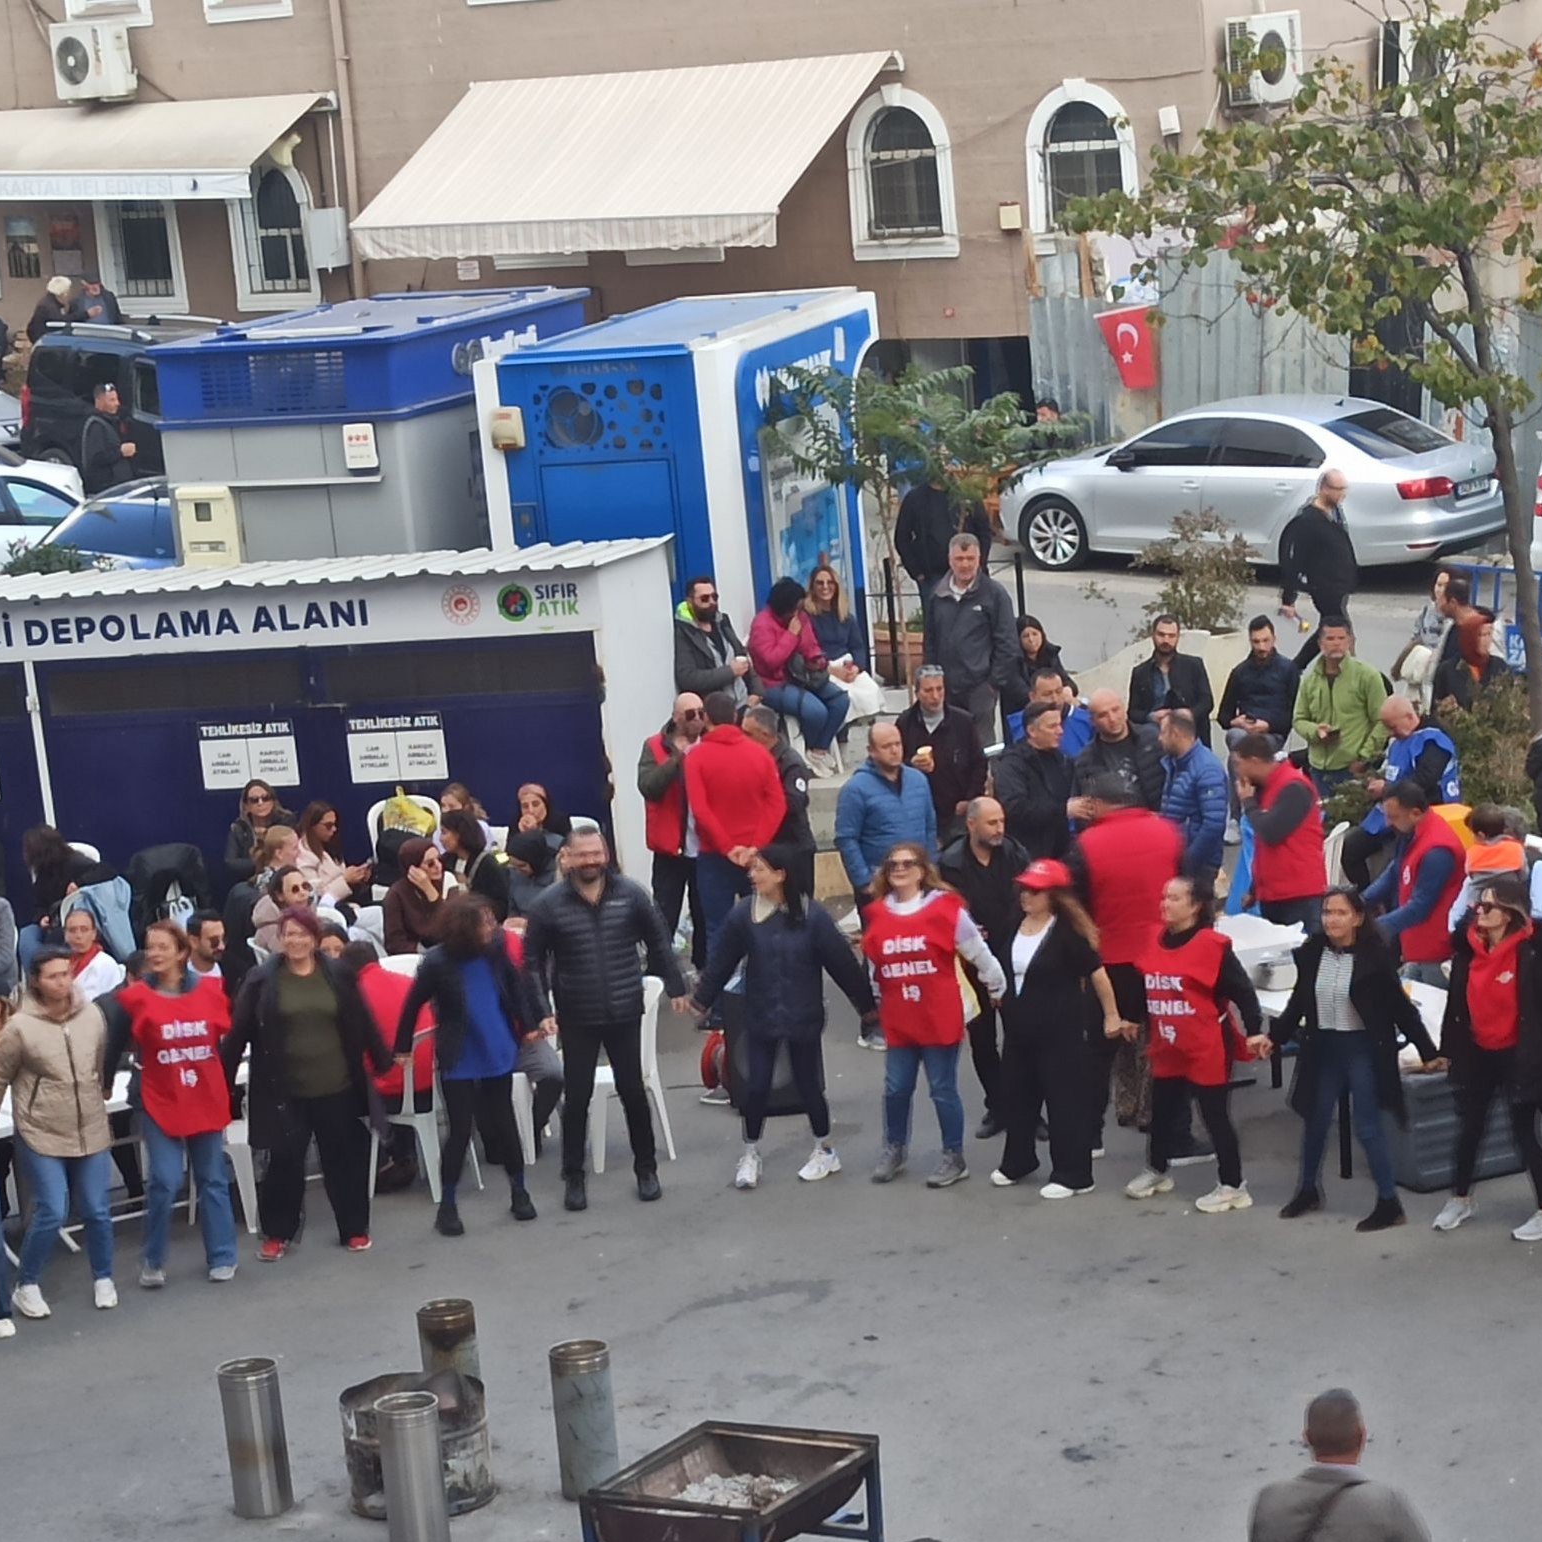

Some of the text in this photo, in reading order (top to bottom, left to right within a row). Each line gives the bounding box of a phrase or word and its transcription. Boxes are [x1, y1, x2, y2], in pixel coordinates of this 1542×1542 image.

[534, 582, 579, 600] SIFIR
[537, 598, 580, 616] ATIK
[24, 607, 241, 647] DEPOLAMA
[252, 598, 369, 633] ALANI
[265, 722, 290, 734] ATIK
[414, 715, 439, 727] ATIK
[882, 934, 927, 955] DİSK
[1145, 971, 1183, 992] DİSK
[160, 1018, 208, 1040] DİSK
